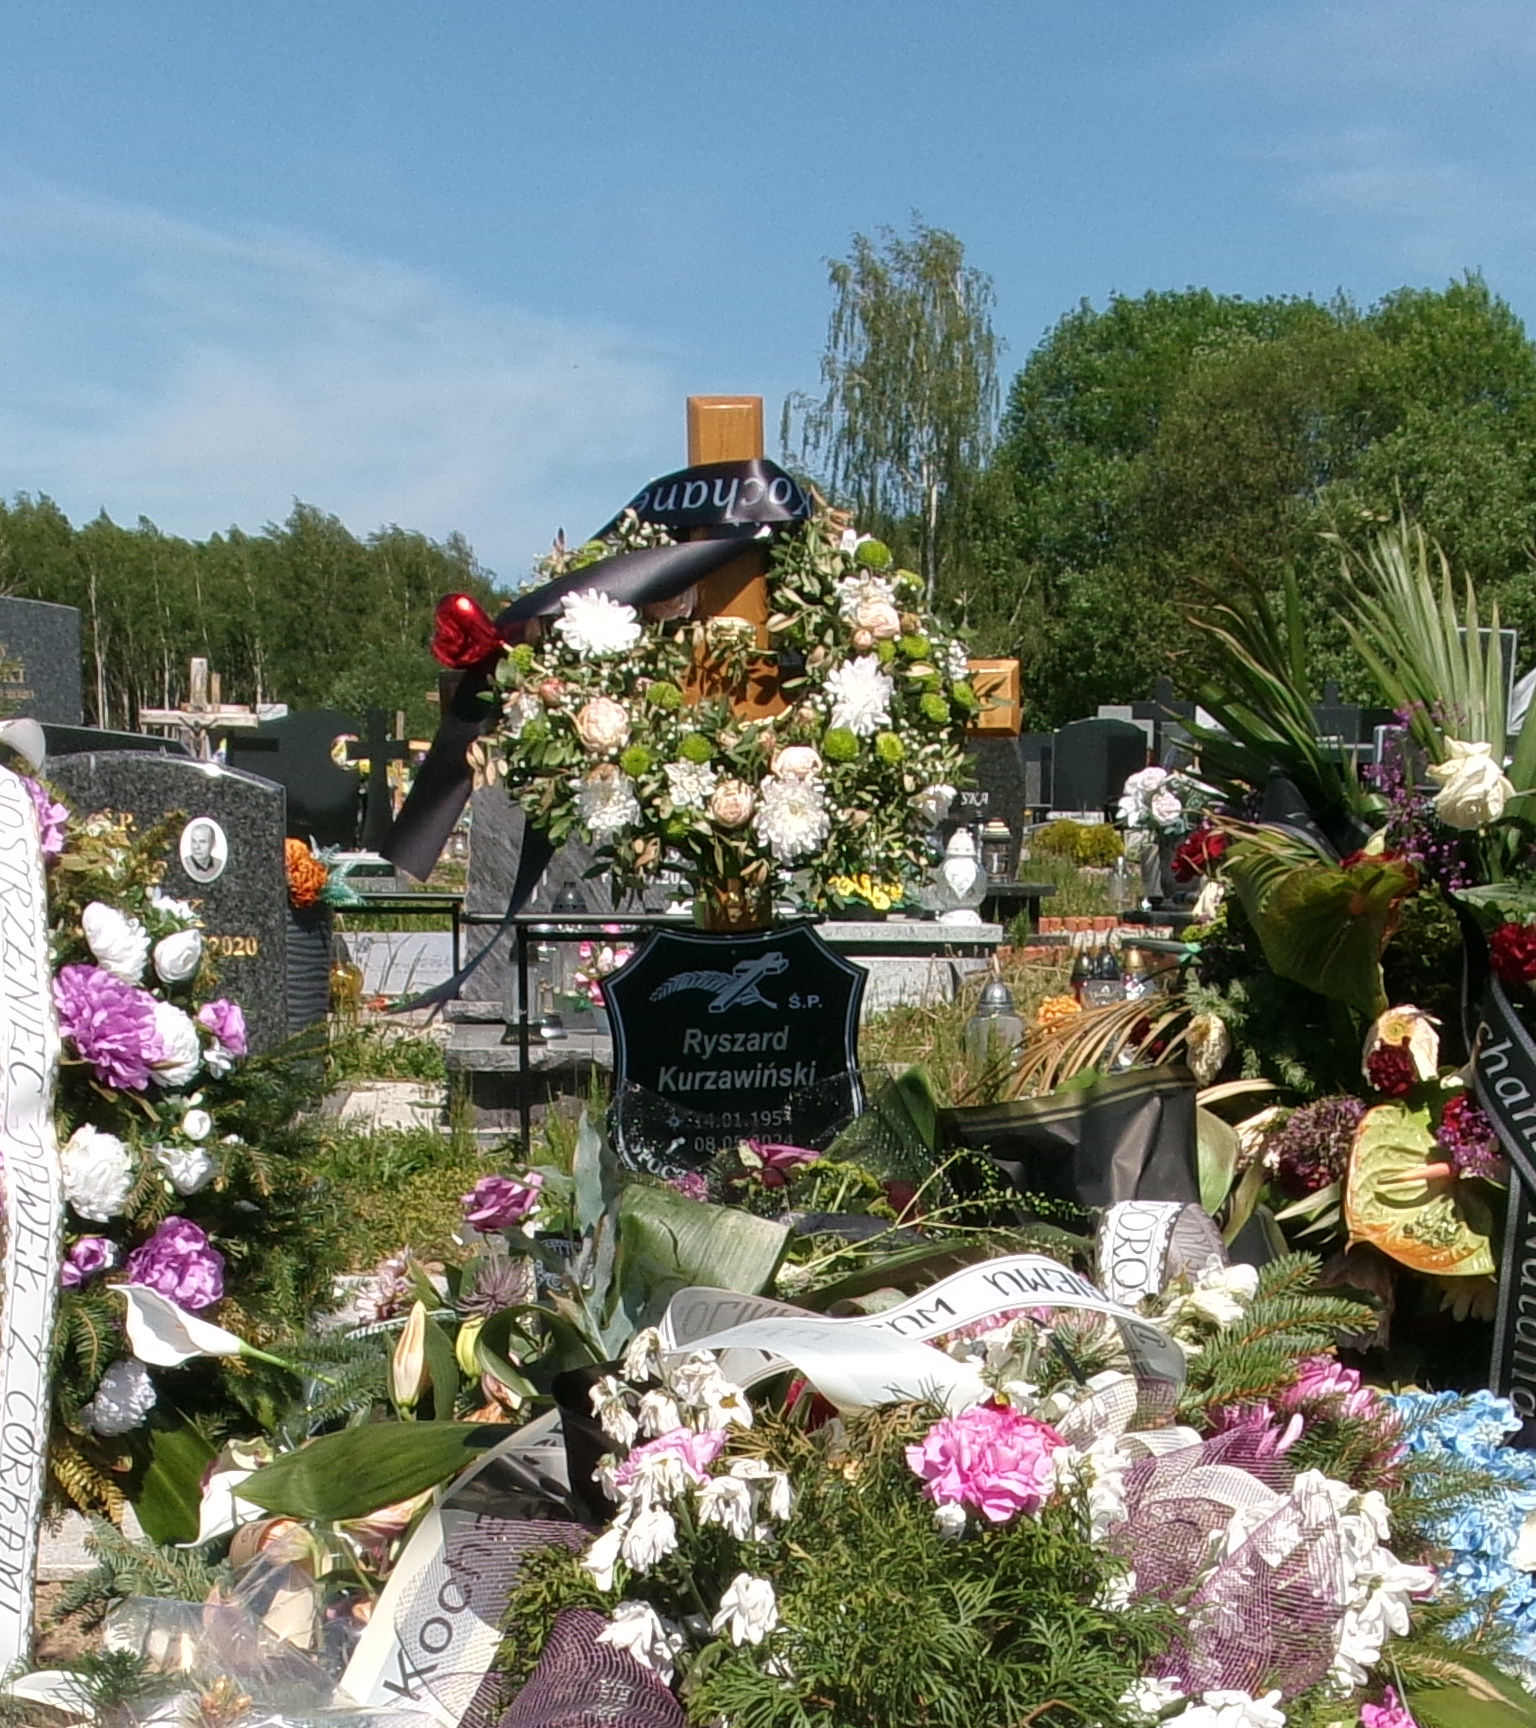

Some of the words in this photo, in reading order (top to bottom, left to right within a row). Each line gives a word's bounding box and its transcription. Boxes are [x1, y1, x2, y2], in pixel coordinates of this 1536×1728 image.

[788, 992, 824, 1009] Ś.P.
[683, 1025, 790, 1060] Ryszard
[657, 1060, 817, 1093] Kurzawiński
